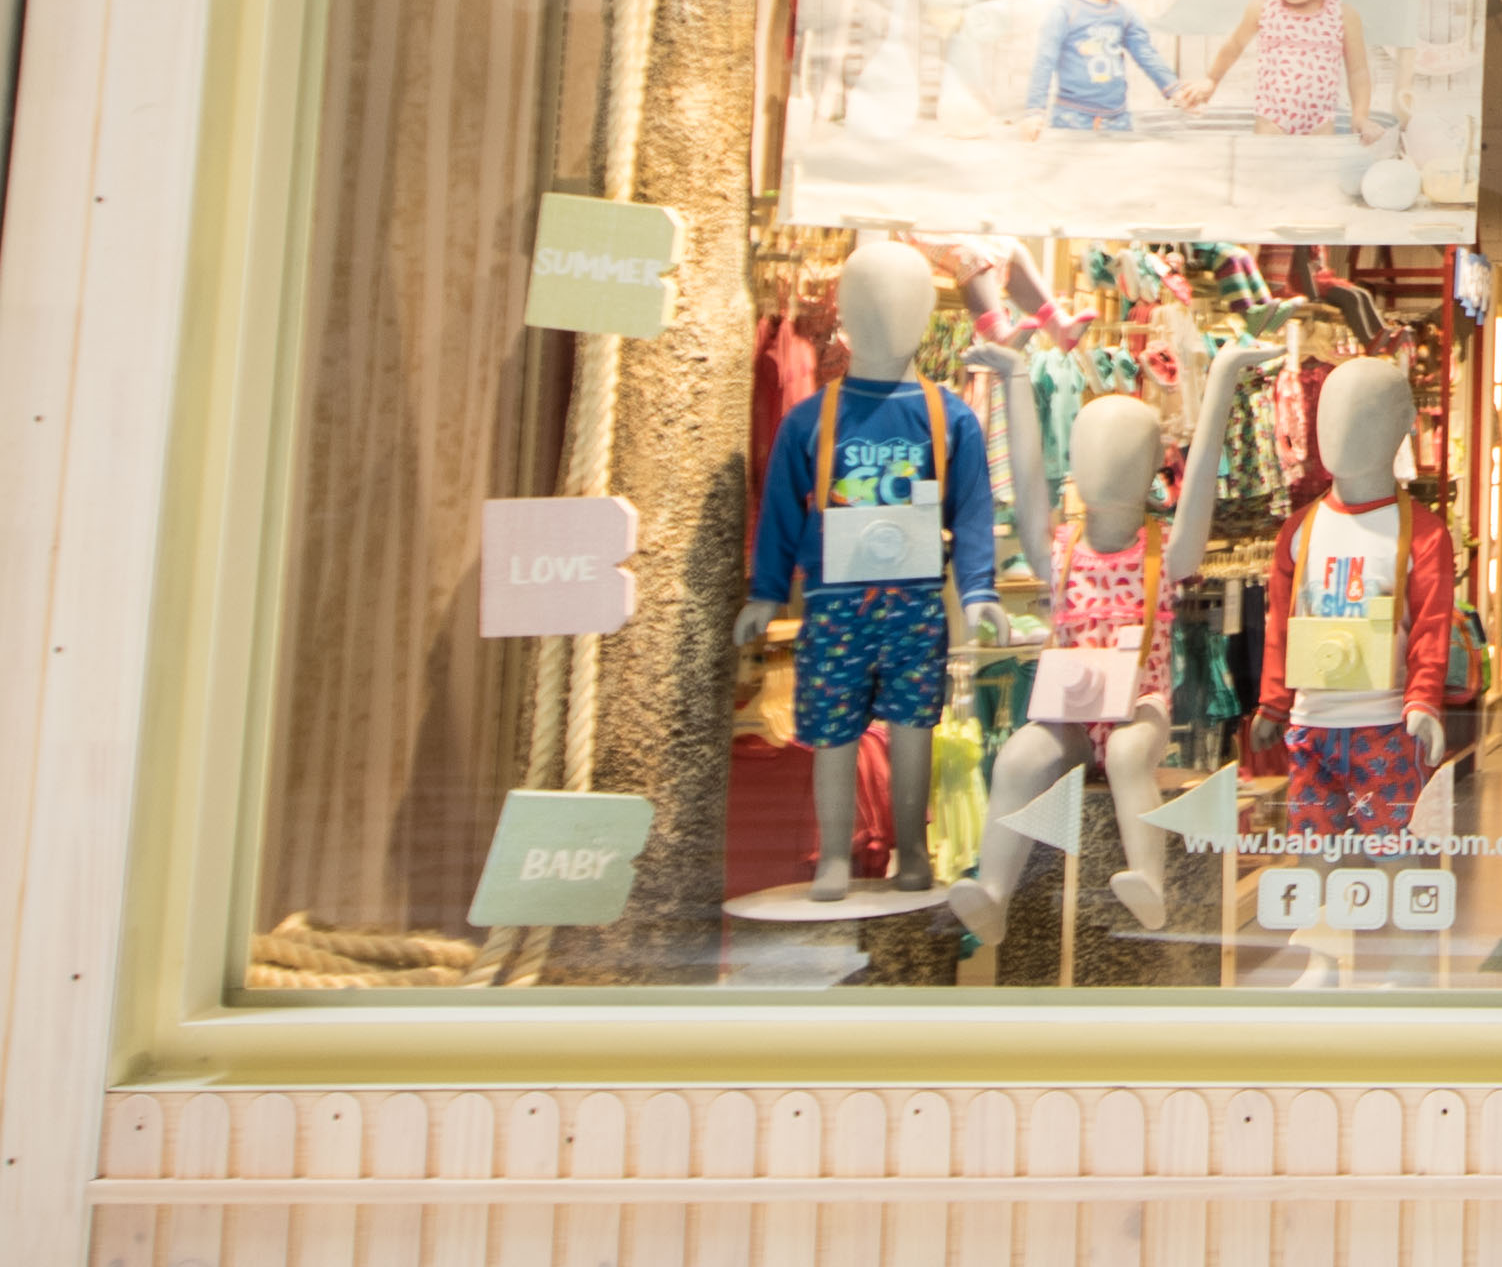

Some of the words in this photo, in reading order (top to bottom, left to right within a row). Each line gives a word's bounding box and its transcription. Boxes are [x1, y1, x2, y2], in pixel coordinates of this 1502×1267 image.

[534, 247, 663, 289] SUMMER
[844, 444, 923, 467] SUPER
[510, 555, 597, 584] LOVE
[519, 848, 618, 880] BABY
